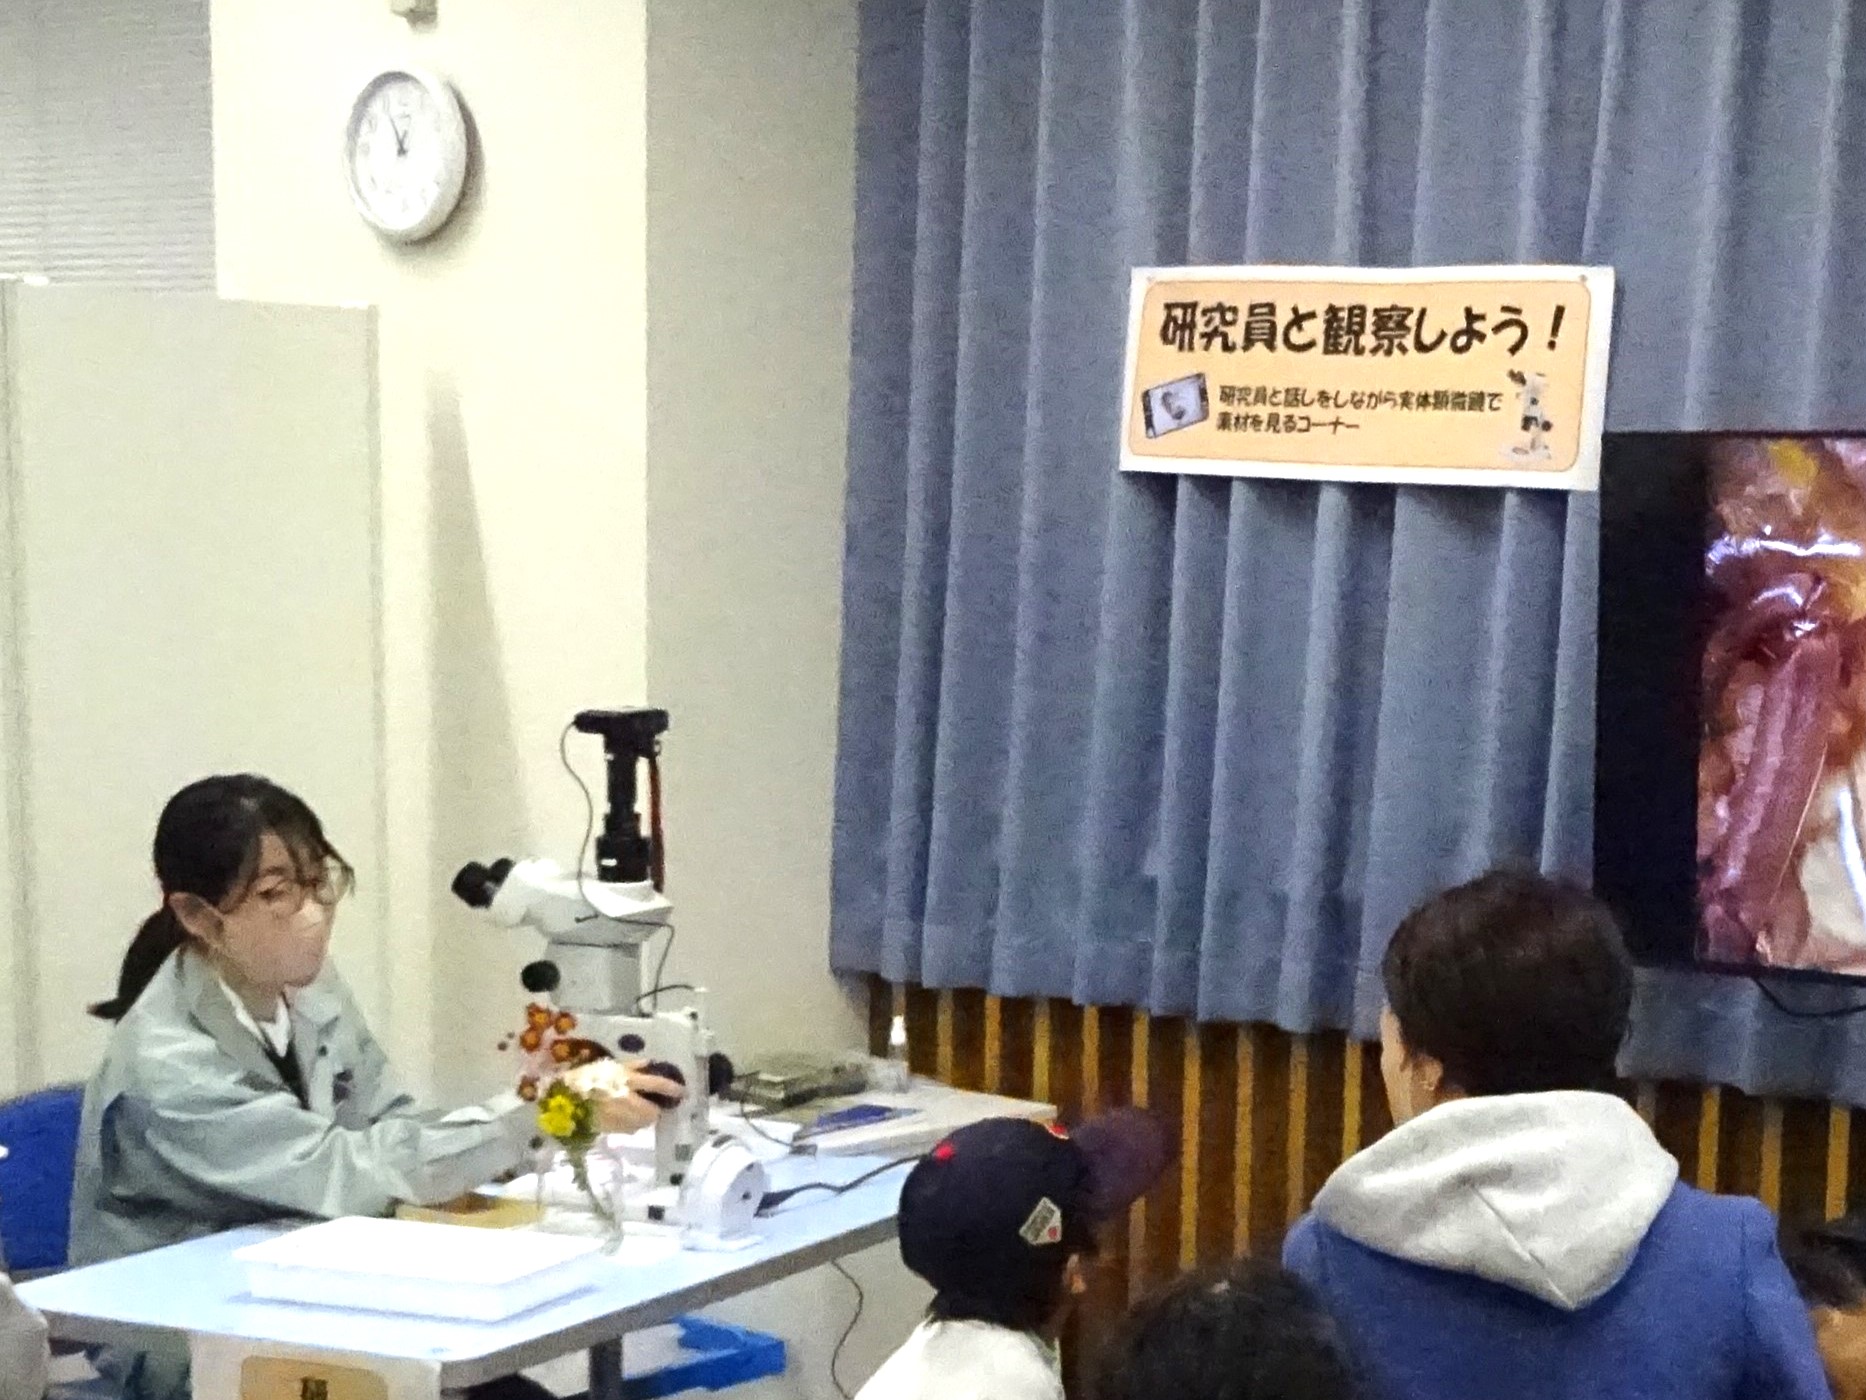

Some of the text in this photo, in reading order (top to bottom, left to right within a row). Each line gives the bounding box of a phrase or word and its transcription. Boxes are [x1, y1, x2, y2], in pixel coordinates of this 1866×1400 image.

[1160, 302, 1567, 357] 研究員と観察しよう！
[1216, 412, 1360, 435] 素材を見るコーナー
